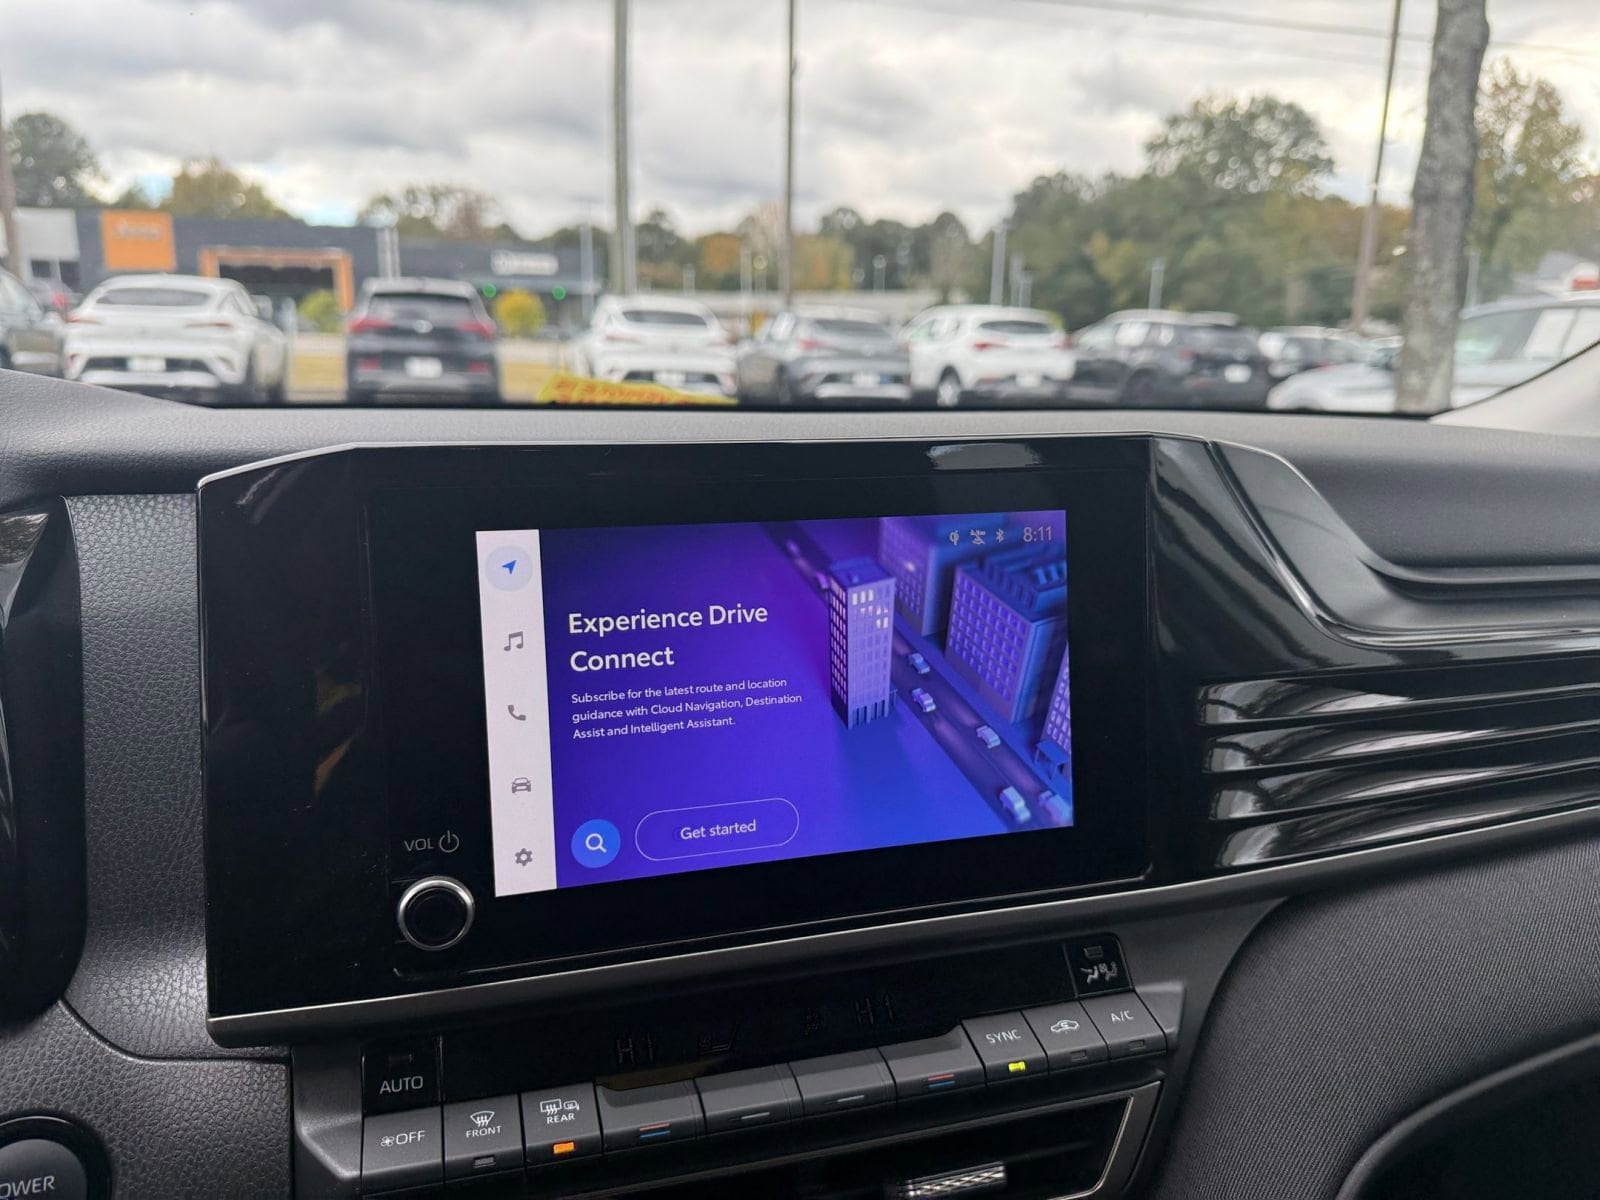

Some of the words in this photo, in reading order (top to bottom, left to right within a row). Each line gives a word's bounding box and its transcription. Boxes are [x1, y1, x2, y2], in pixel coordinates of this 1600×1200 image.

[1023, 526, 1052, 543] 8:11
[568, 608, 703, 637] Experience
[709, 603, 769, 625] Drive
[569, 647, 675, 672] Connect
[571, 690, 626, 704] Subscribe
[627, 688, 642, 700] for
[645, 687, 662, 698] the
[664, 684, 694, 697] latest
[695, 684, 724, 694] route
[725, 680, 746, 692] and
[747, 678, 787, 690] location
[572, 708, 623, 723] guidance
[626, 706, 648, 717] with
[650, 703, 683, 715] Cloud
[685, 699, 744, 713] Navigation,
[746, 694, 802, 708] Destination
[573, 727, 605, 740] Assist
[606, 724, 628, 736] and
[630, 720, 685, 735] Intelligent
[686, 716, 736, 729] Assistant.
[680, 826, 706, 840] Get
[709, 818, 757, 837] started
[403, 838, 435, 852] VOL
[1110, 1010, 1135, 1023] A/C
[985, 1029, 1022, 1045] SYNC
[379, 1075, 424, 1095] AUTO
[547, 1112, 576, 1125] REAR
[395, 1130, 426, 1145] OFF
[466, 1125, 503, 1139] FRONT
[0, 1175, 55, 1198] OWER
